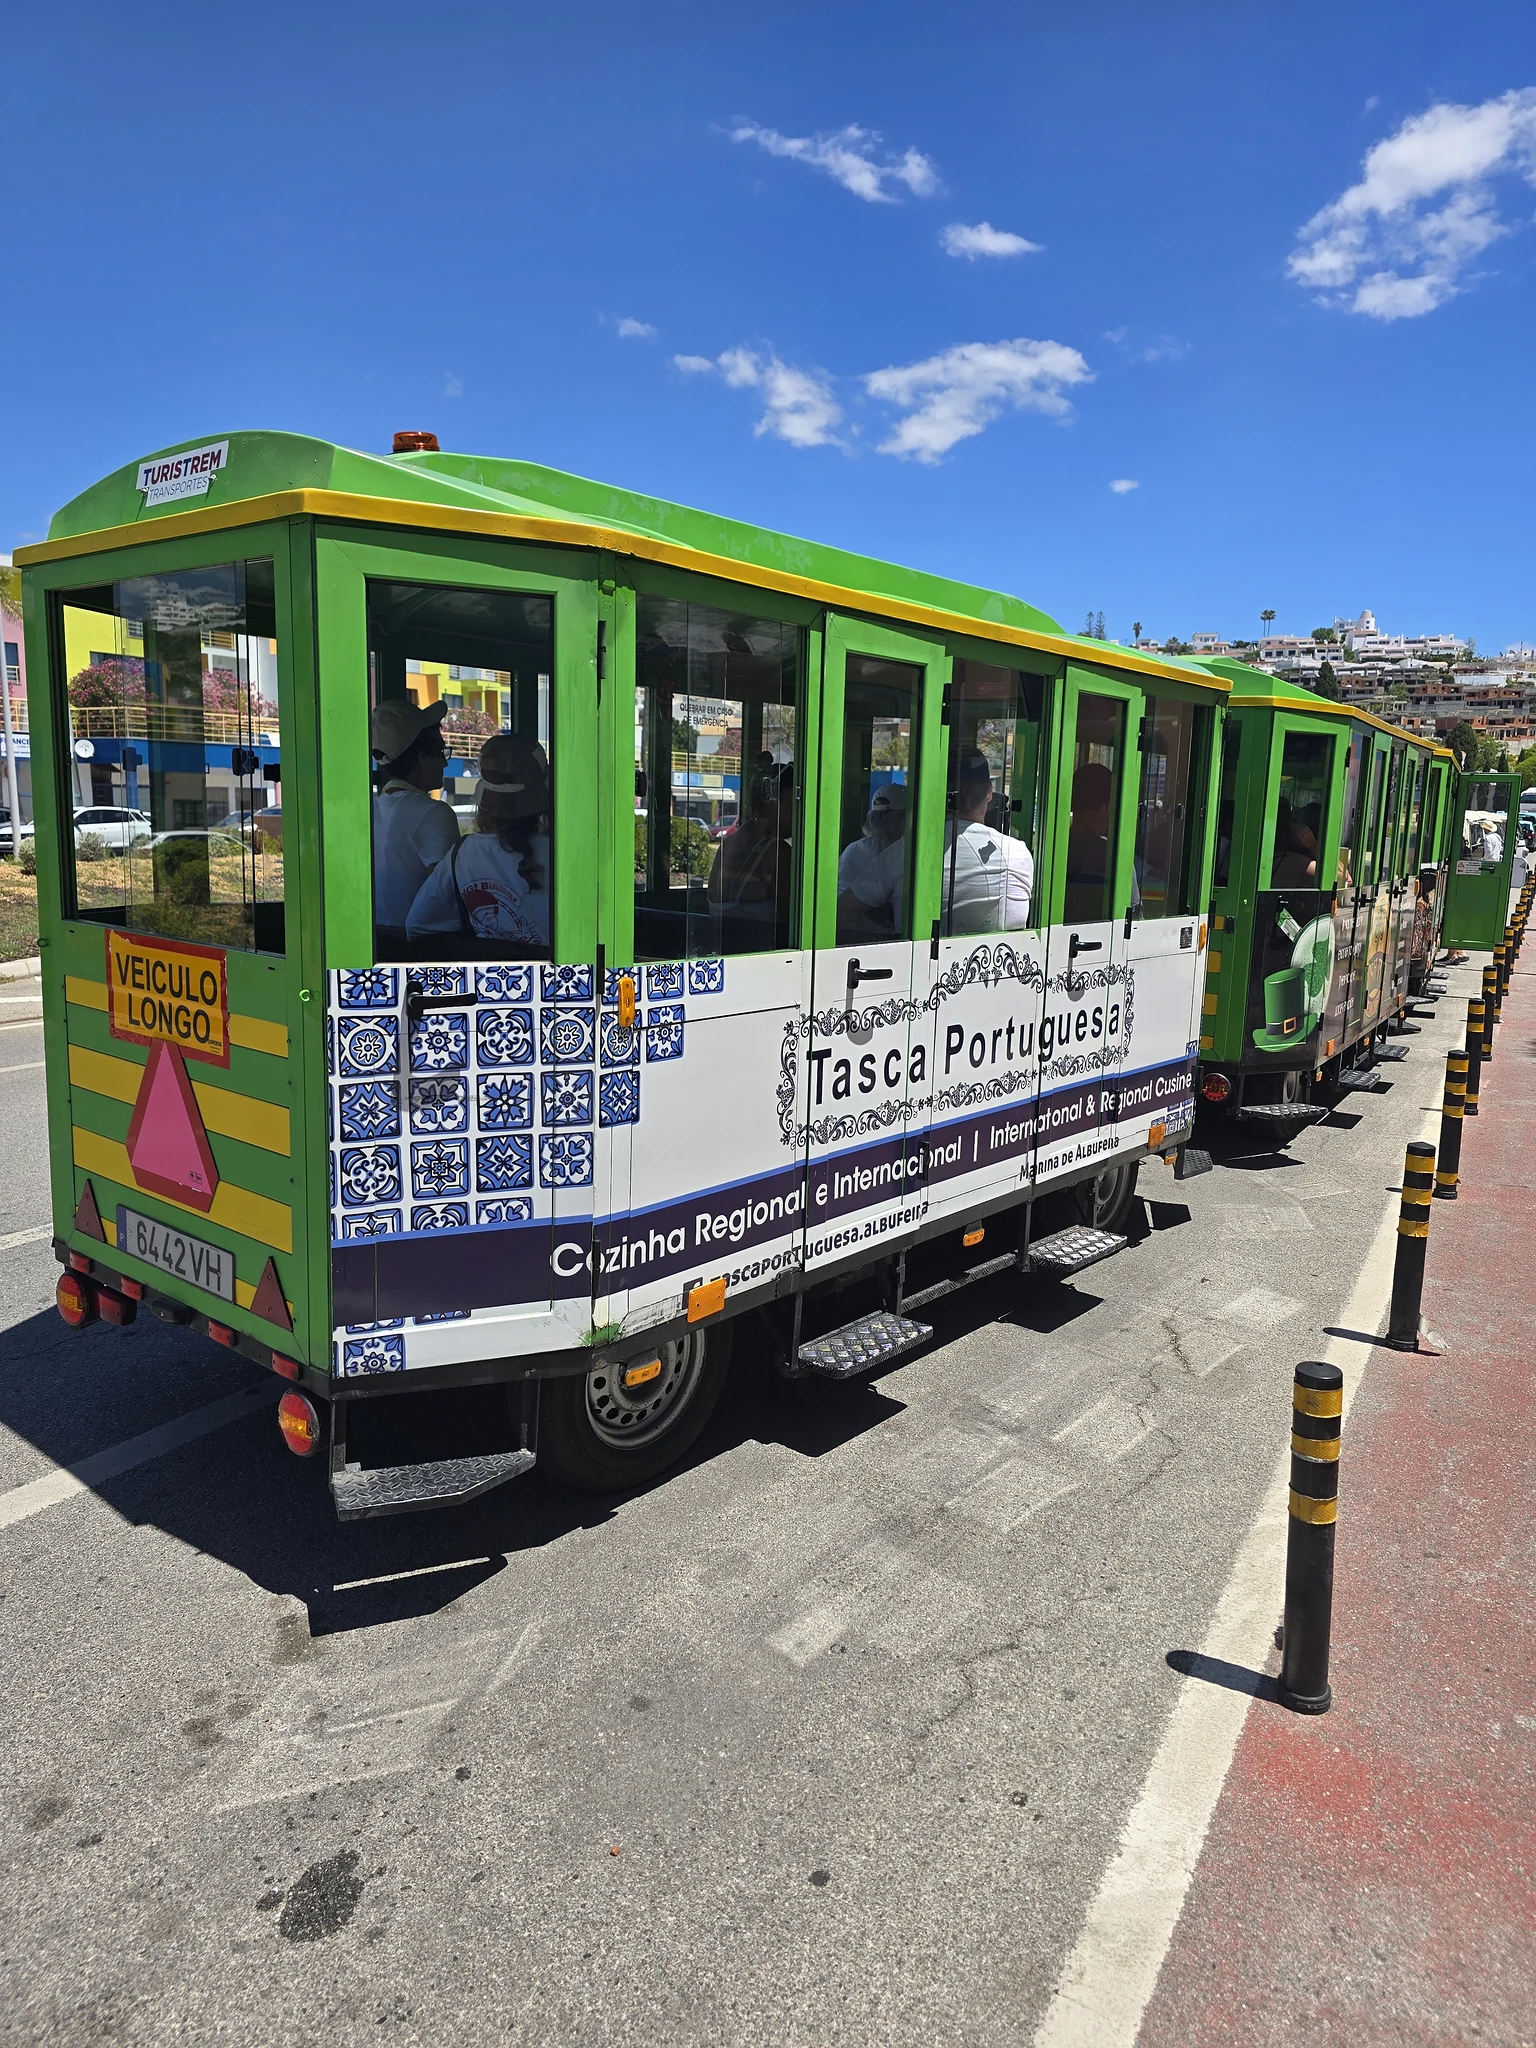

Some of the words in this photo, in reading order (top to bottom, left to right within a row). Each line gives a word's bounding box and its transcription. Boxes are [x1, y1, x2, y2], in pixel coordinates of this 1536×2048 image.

[143, 449, 222, 486] TURISTREM
[149, 475, 208, 500] TRANSPORTES
[680, 703, 706, 714] QUEBRAR
[707, 706, 716, 715] EM
[717, 707, 733, 716] CASO
[684, 715, 692, 725] DE
[116, 952, 218, 1006] VEICULO
[128, 992, 211, 1044] LONGO
[944, 1003, 1120, 1075] Portuguesa
[806, 1044, 926, 1105] Tasca
[550, 1226, 686, 1277] Cozinha
[695, 1181, 806, 1246] Regional
[815, 1183, 828, 1206] e
[1086, 1094, 1096, 1117] &
[1155, 1072, 1192, 1097] Cusine
[137, 1220, 221, 1292] 6442VH
